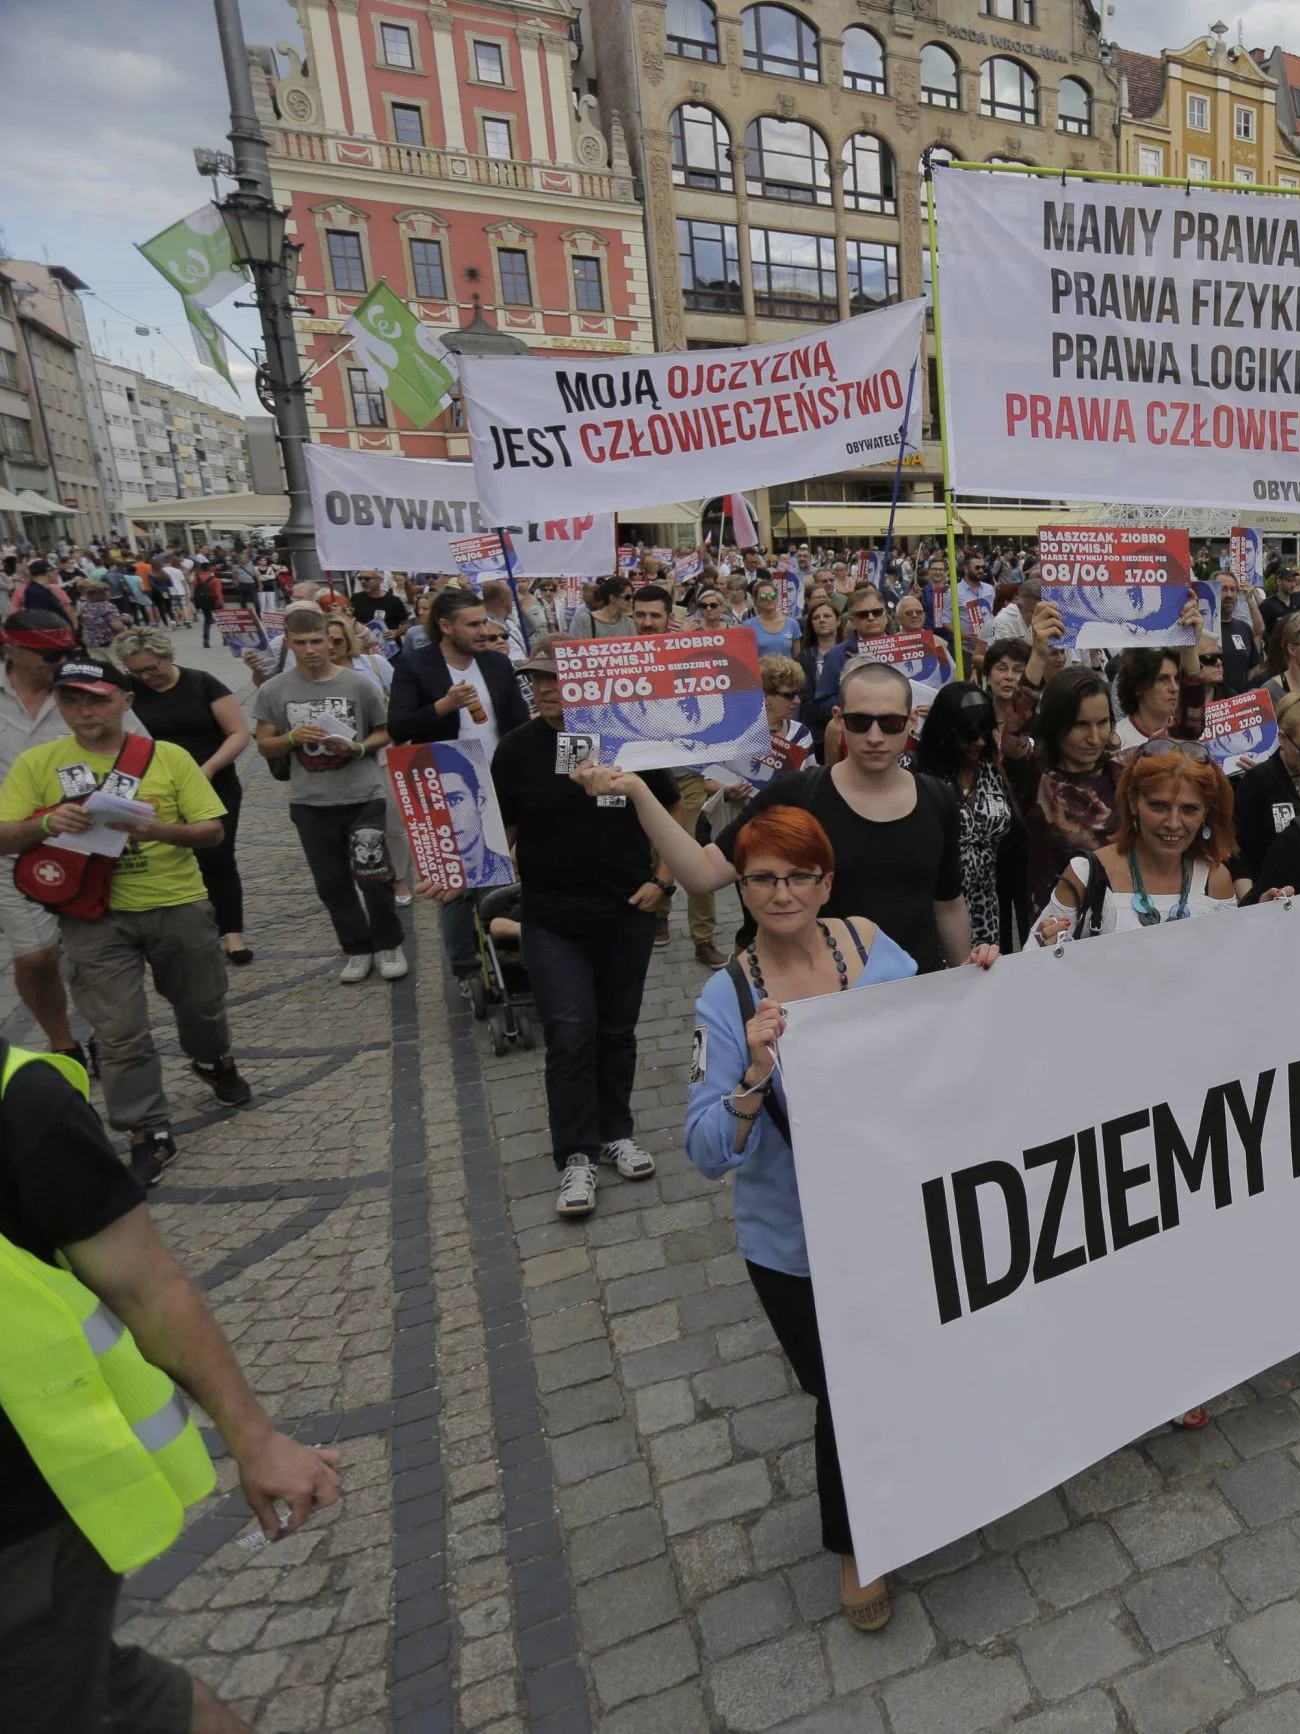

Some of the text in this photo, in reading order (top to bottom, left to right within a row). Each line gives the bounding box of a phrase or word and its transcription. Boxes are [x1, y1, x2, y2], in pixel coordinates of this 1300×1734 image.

[946, 24, 987, 46] MODA
[1042, 200, 1163, 257] MAMY
[1050, 267, 1180, 325] PRAWA
[1052, 331, 1181, 385] PRAWA
[555, 340, 838, 413] MOJĄ OJCZYZNĄ
[489, 368, 904, 470] JEST CZŁOWIECZEŃSTWO
[1005, 392, 1136, 444] PRAWA
[846, 433, 901, 454] OBYWATELE
[1039, 531, 1166, 544] BŁASZCZAK, ZIOBRO
[1040, 543, 1113, 554] DO DYMISJI
[1041, 563, 1168, 585] 08/06 17.00
[555, 635, 725, 659] BŁASZCZAK, ZIOBRO
[556, 653, 655, 671] DO DYMISJI
[559, 671, 597, 680] MARSZ
[598, 669, 605, 677] Z
[607, 666, 642, 676] RYNKU
[644, 664, 665, 673] POD
[668, 661, 712, 671] SIEDZIBĘ
[562, 674, 731, 703] 08/06 17.00
[1239, 715, 1262, 728] 17.00
[394, 771, 431, 881] ASZCZAK, ZIOBRO
[424, 767, 463, 888] 08/06 17.00
[425, 815, 433, 831] POD
[418, 822, 439, 871] DYMISJI
[921, 1068, 1276, 1325] IDZIEMY
